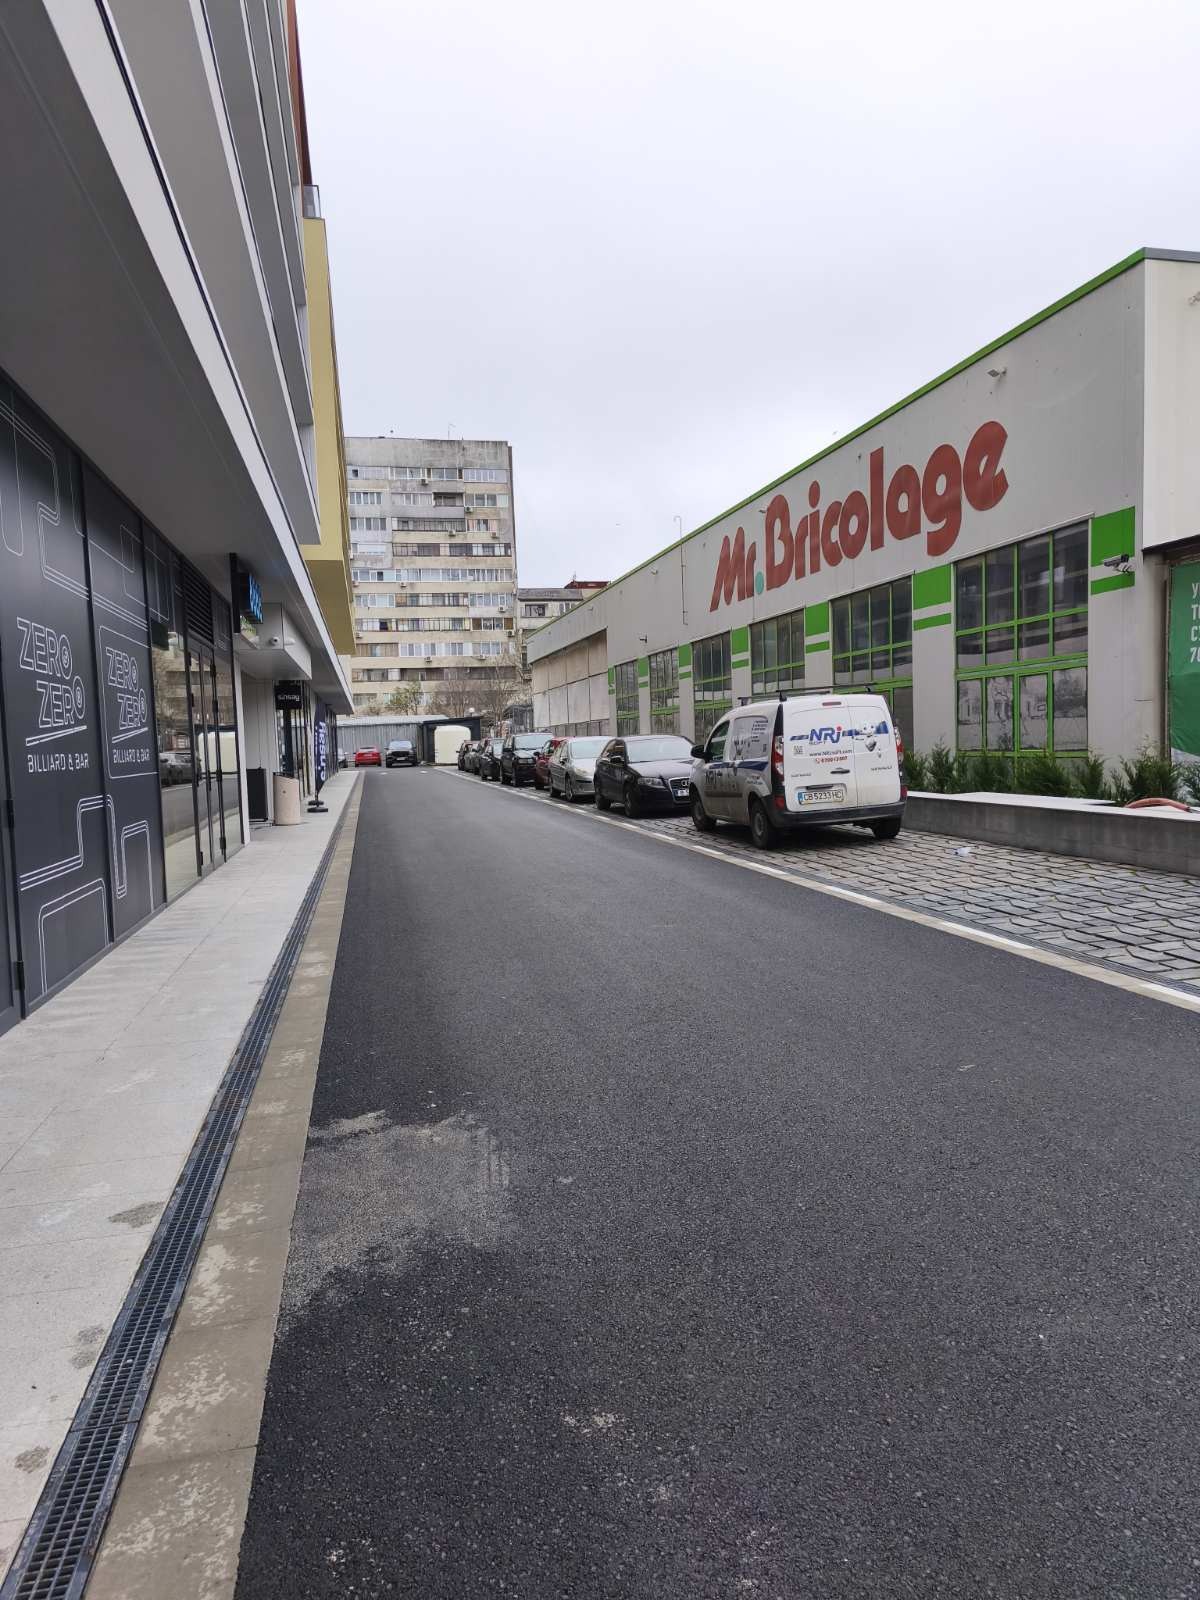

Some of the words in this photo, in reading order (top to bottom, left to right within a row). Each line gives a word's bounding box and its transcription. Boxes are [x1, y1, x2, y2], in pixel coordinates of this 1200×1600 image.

[709, 525, 765, 613] Mr.
[764, 420, 1009, 592] Bricolage
[16, 616, 73, 680] ZERO
[106, 646, 139, 692] ZERO
[36, 675, 86, 729] ZERO
[117, 688, 148, 731] ZERO
[27, 753, 66, 774] BILLIARD
[68, 754, 74, 772] &
[75, 753, 90, 771] BAR
[112, 748, 136, 764] BILLIARD
[140, 748, 151, 762] BAR
